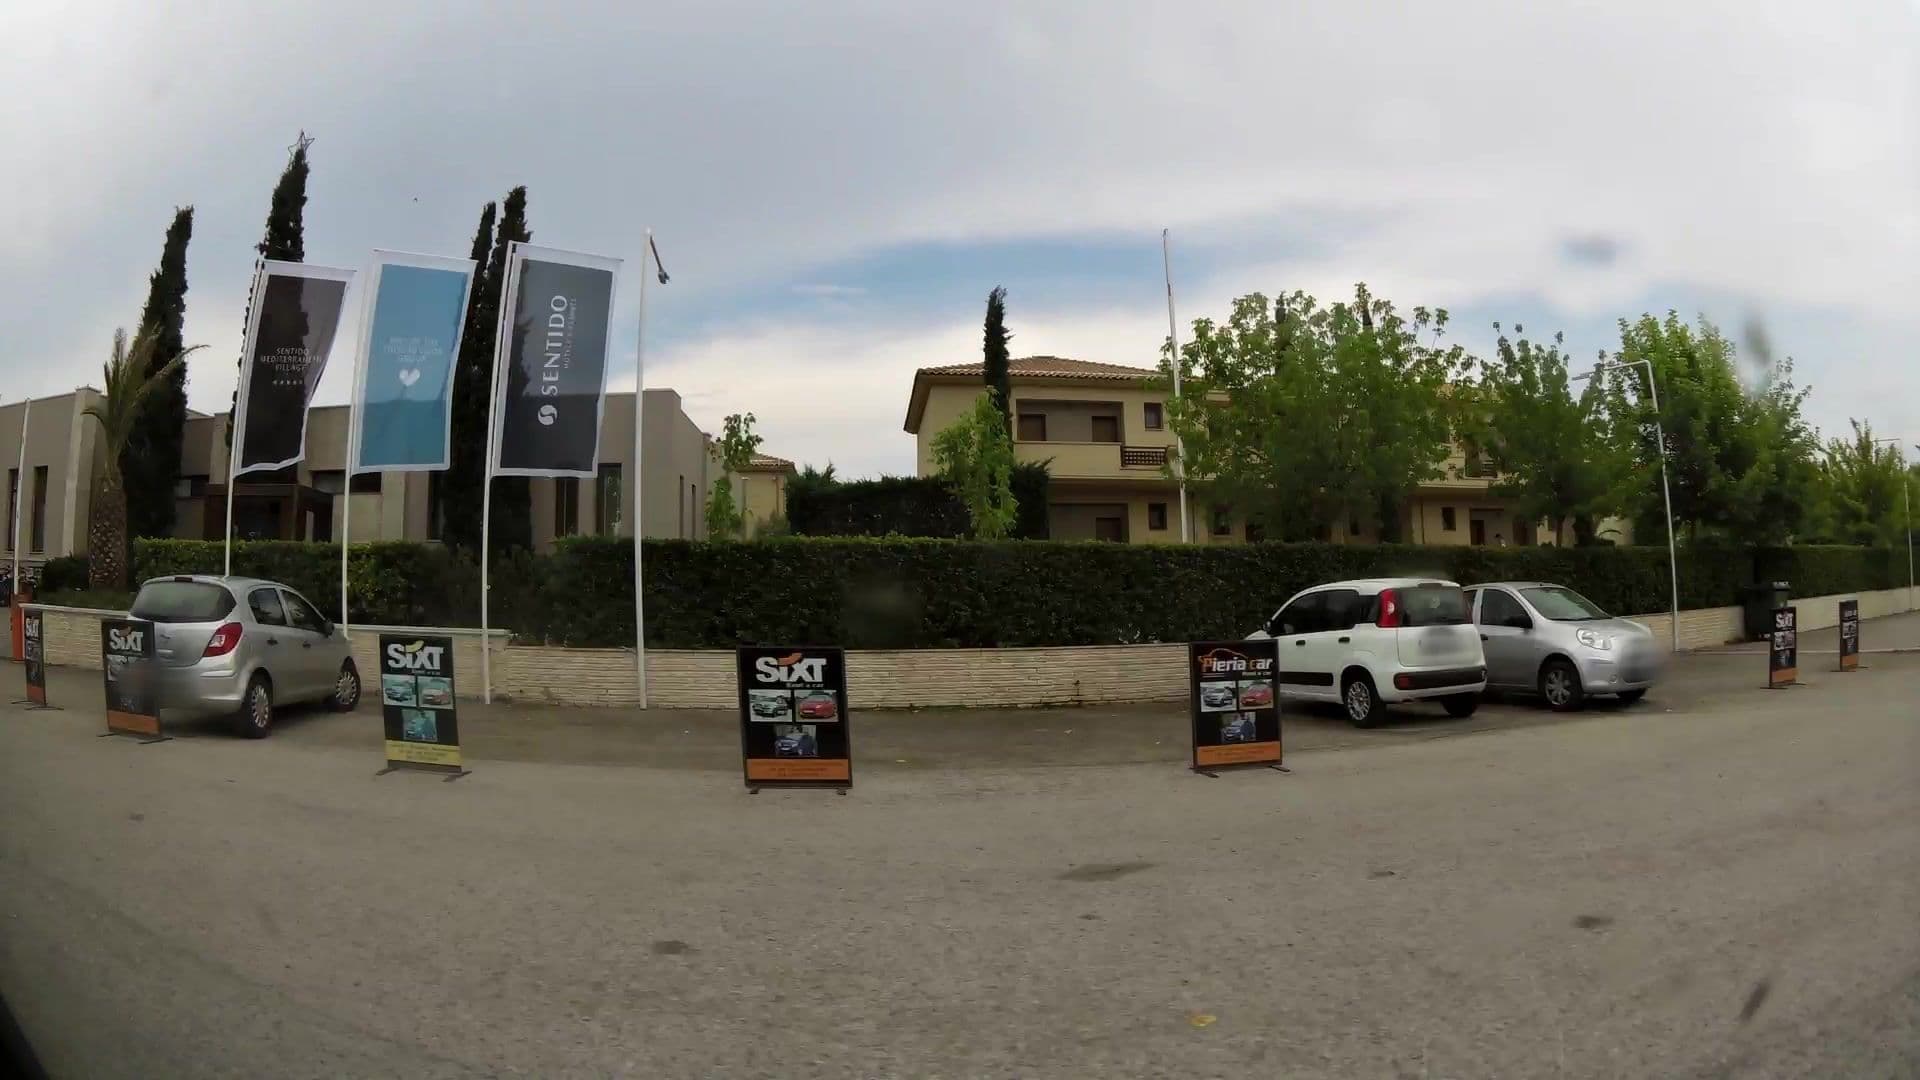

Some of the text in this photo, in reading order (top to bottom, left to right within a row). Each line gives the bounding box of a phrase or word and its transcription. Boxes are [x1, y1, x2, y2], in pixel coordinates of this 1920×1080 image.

[276, 347, 310, 355] SENTIDO
[541, 295, 568, 396] SENTIDO
[1249, 658, 1273, 670] car
